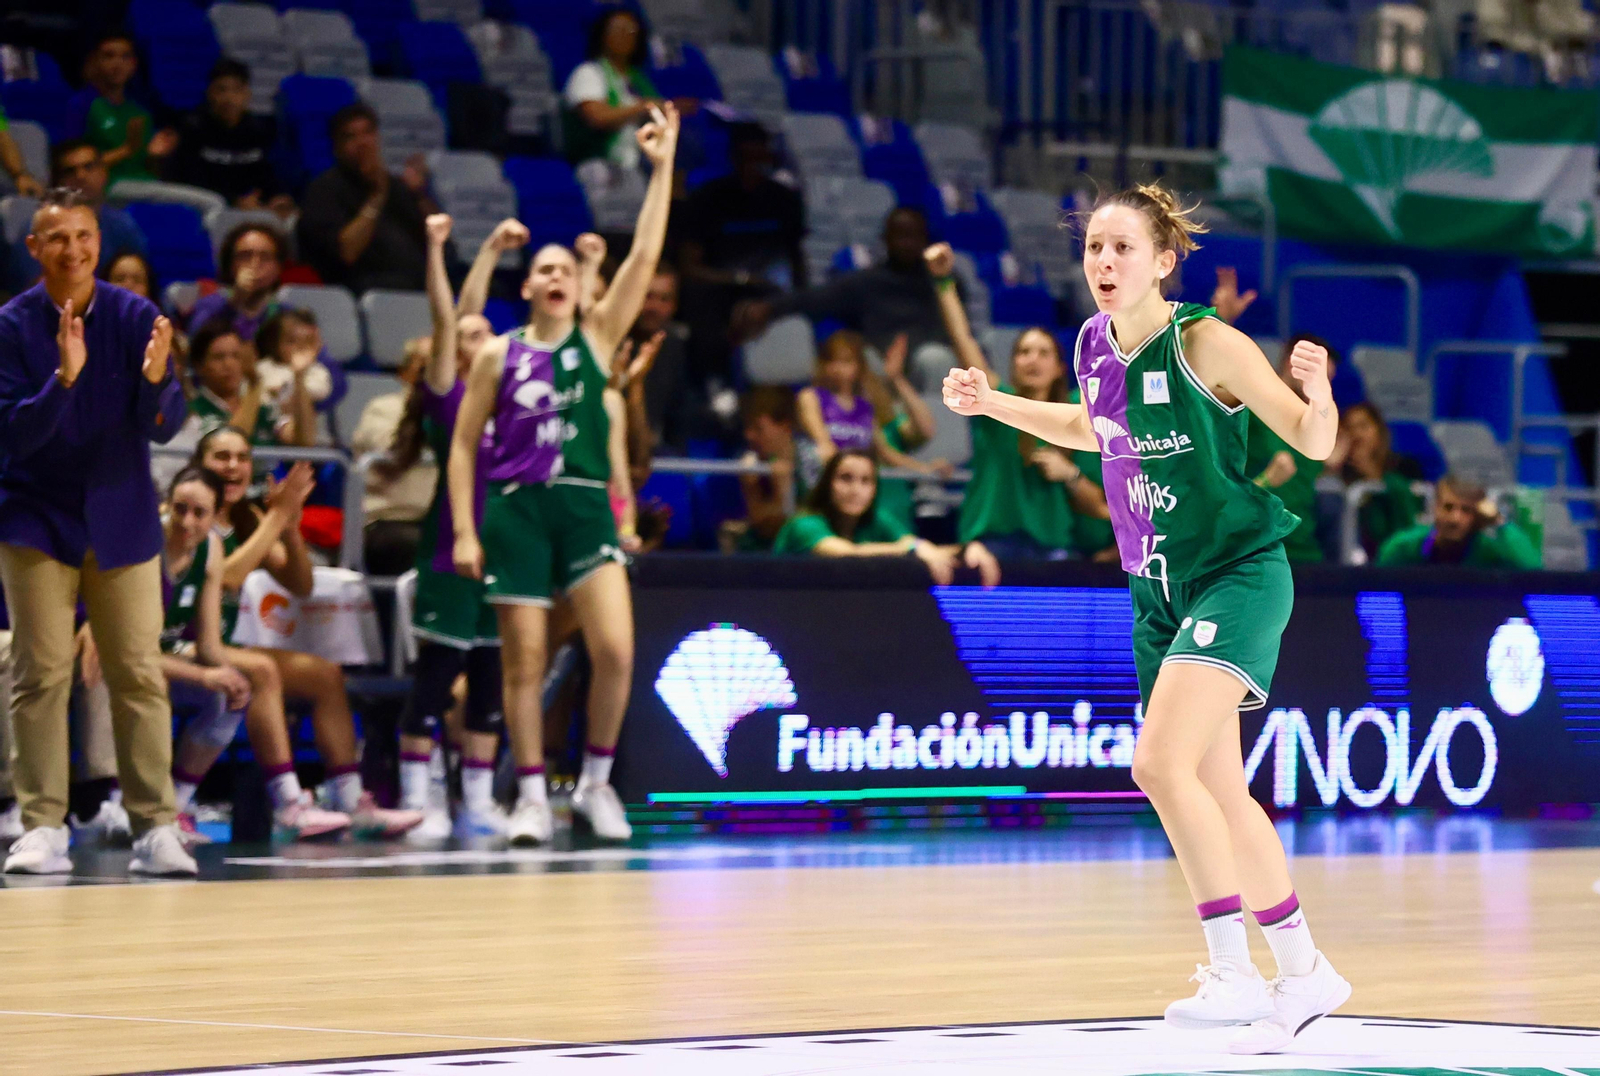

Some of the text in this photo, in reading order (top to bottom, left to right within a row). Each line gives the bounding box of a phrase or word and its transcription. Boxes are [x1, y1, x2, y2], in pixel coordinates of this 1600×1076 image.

[1126, 430, 1192, 453] Unicaja
[1126, 473, 1178, 521] Mijas
[1137, 534, 1171, 603] 15
